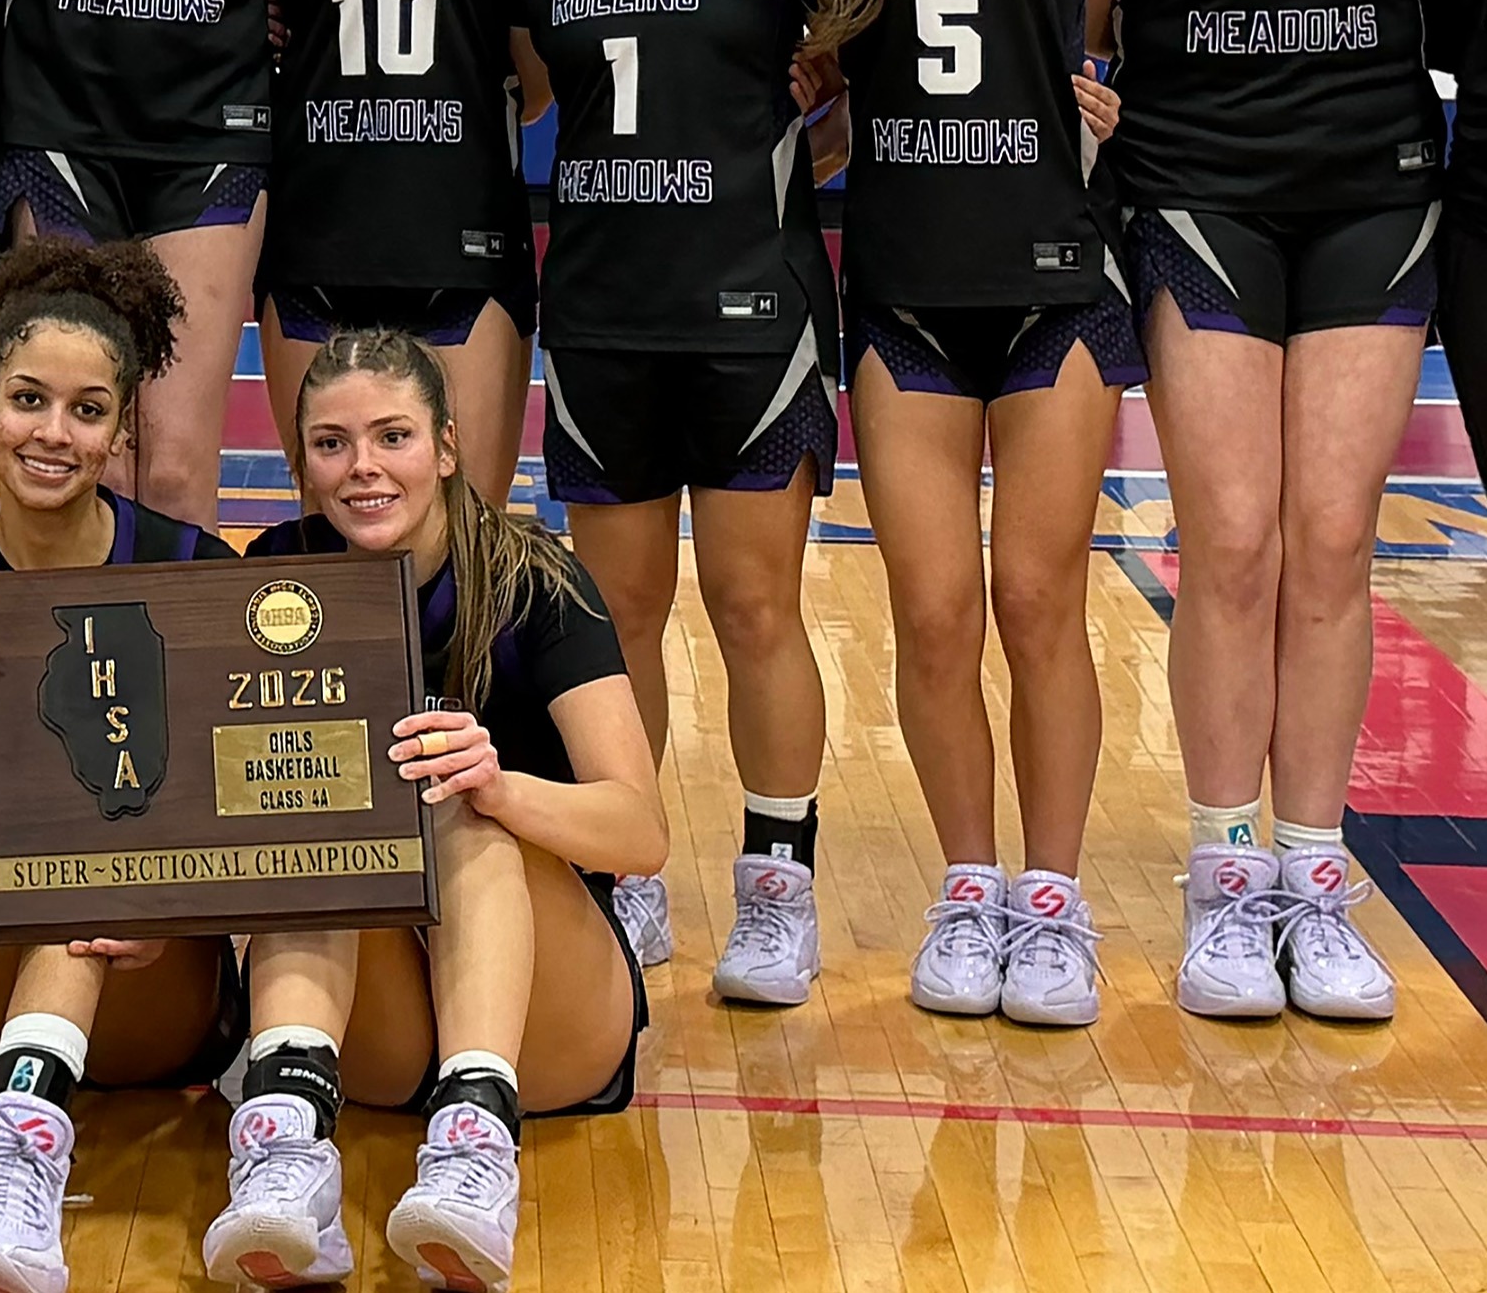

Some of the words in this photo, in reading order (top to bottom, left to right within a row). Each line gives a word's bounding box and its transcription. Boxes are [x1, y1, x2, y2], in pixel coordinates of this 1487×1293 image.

[1186, 5, 1378, 56] MEADOWS
[602, 36, 638, 135] 1
[306, 99, 463, 144] MEADOWS
[872, 117, 1039, 164] MEADOWS
[558, 158, 713, 204] MEADOWS
[228, 667, 346, 709] 2026
[269, 731, 313, 753] GIRLS
[245, 756, 341, 782] BASKETBALL
[260, 790, 303, 810] CLASS
[312, 788, 329, 808] 4A
[255, 844, 400, 876] CHAMPIONS
